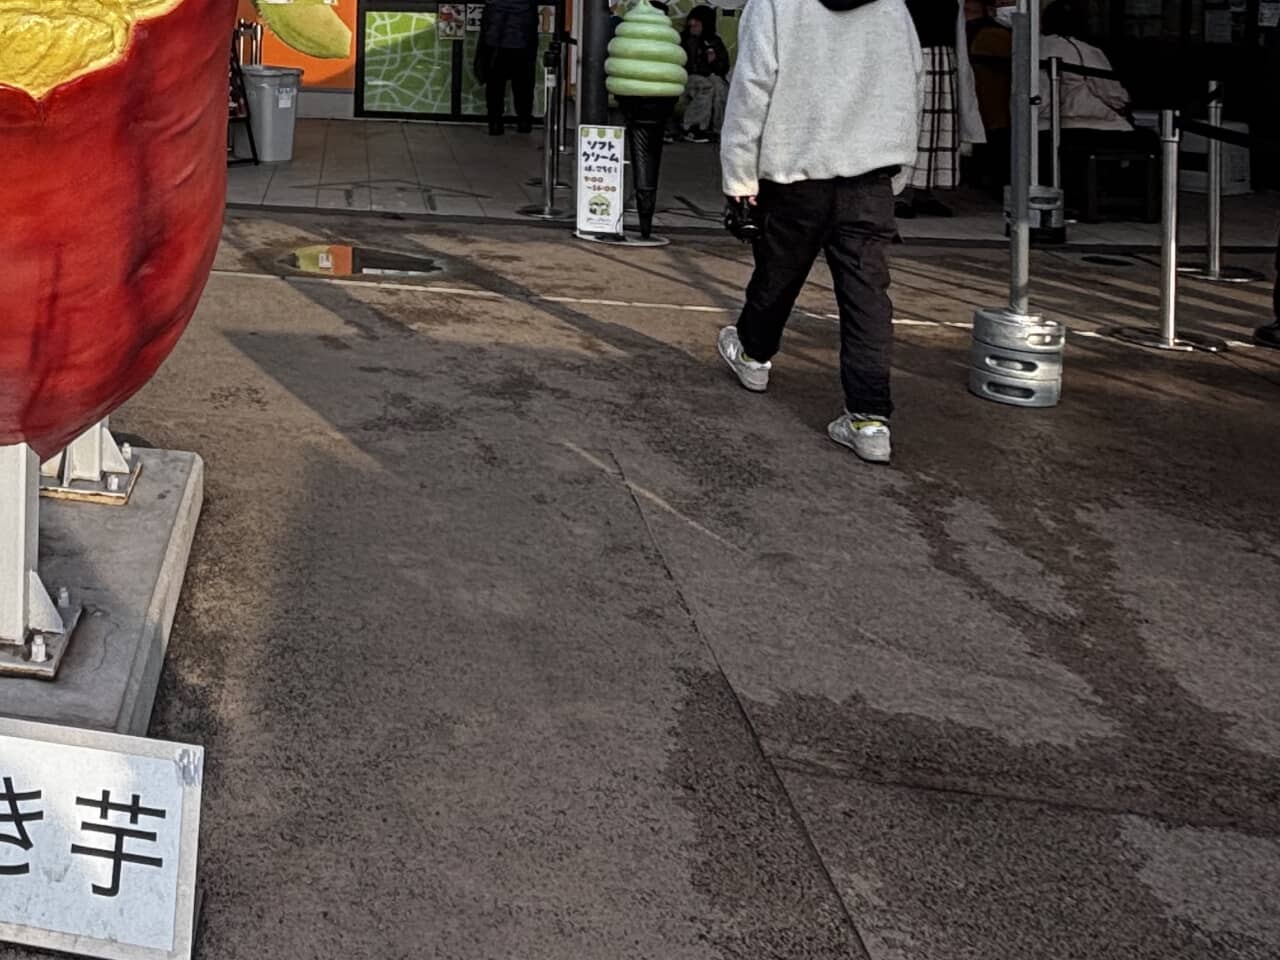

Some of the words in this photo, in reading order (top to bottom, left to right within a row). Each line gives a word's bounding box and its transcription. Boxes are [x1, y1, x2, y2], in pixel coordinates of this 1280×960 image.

[587, 141, 615, 151] ソフト
[582, 151, 619, 163] クリーム
